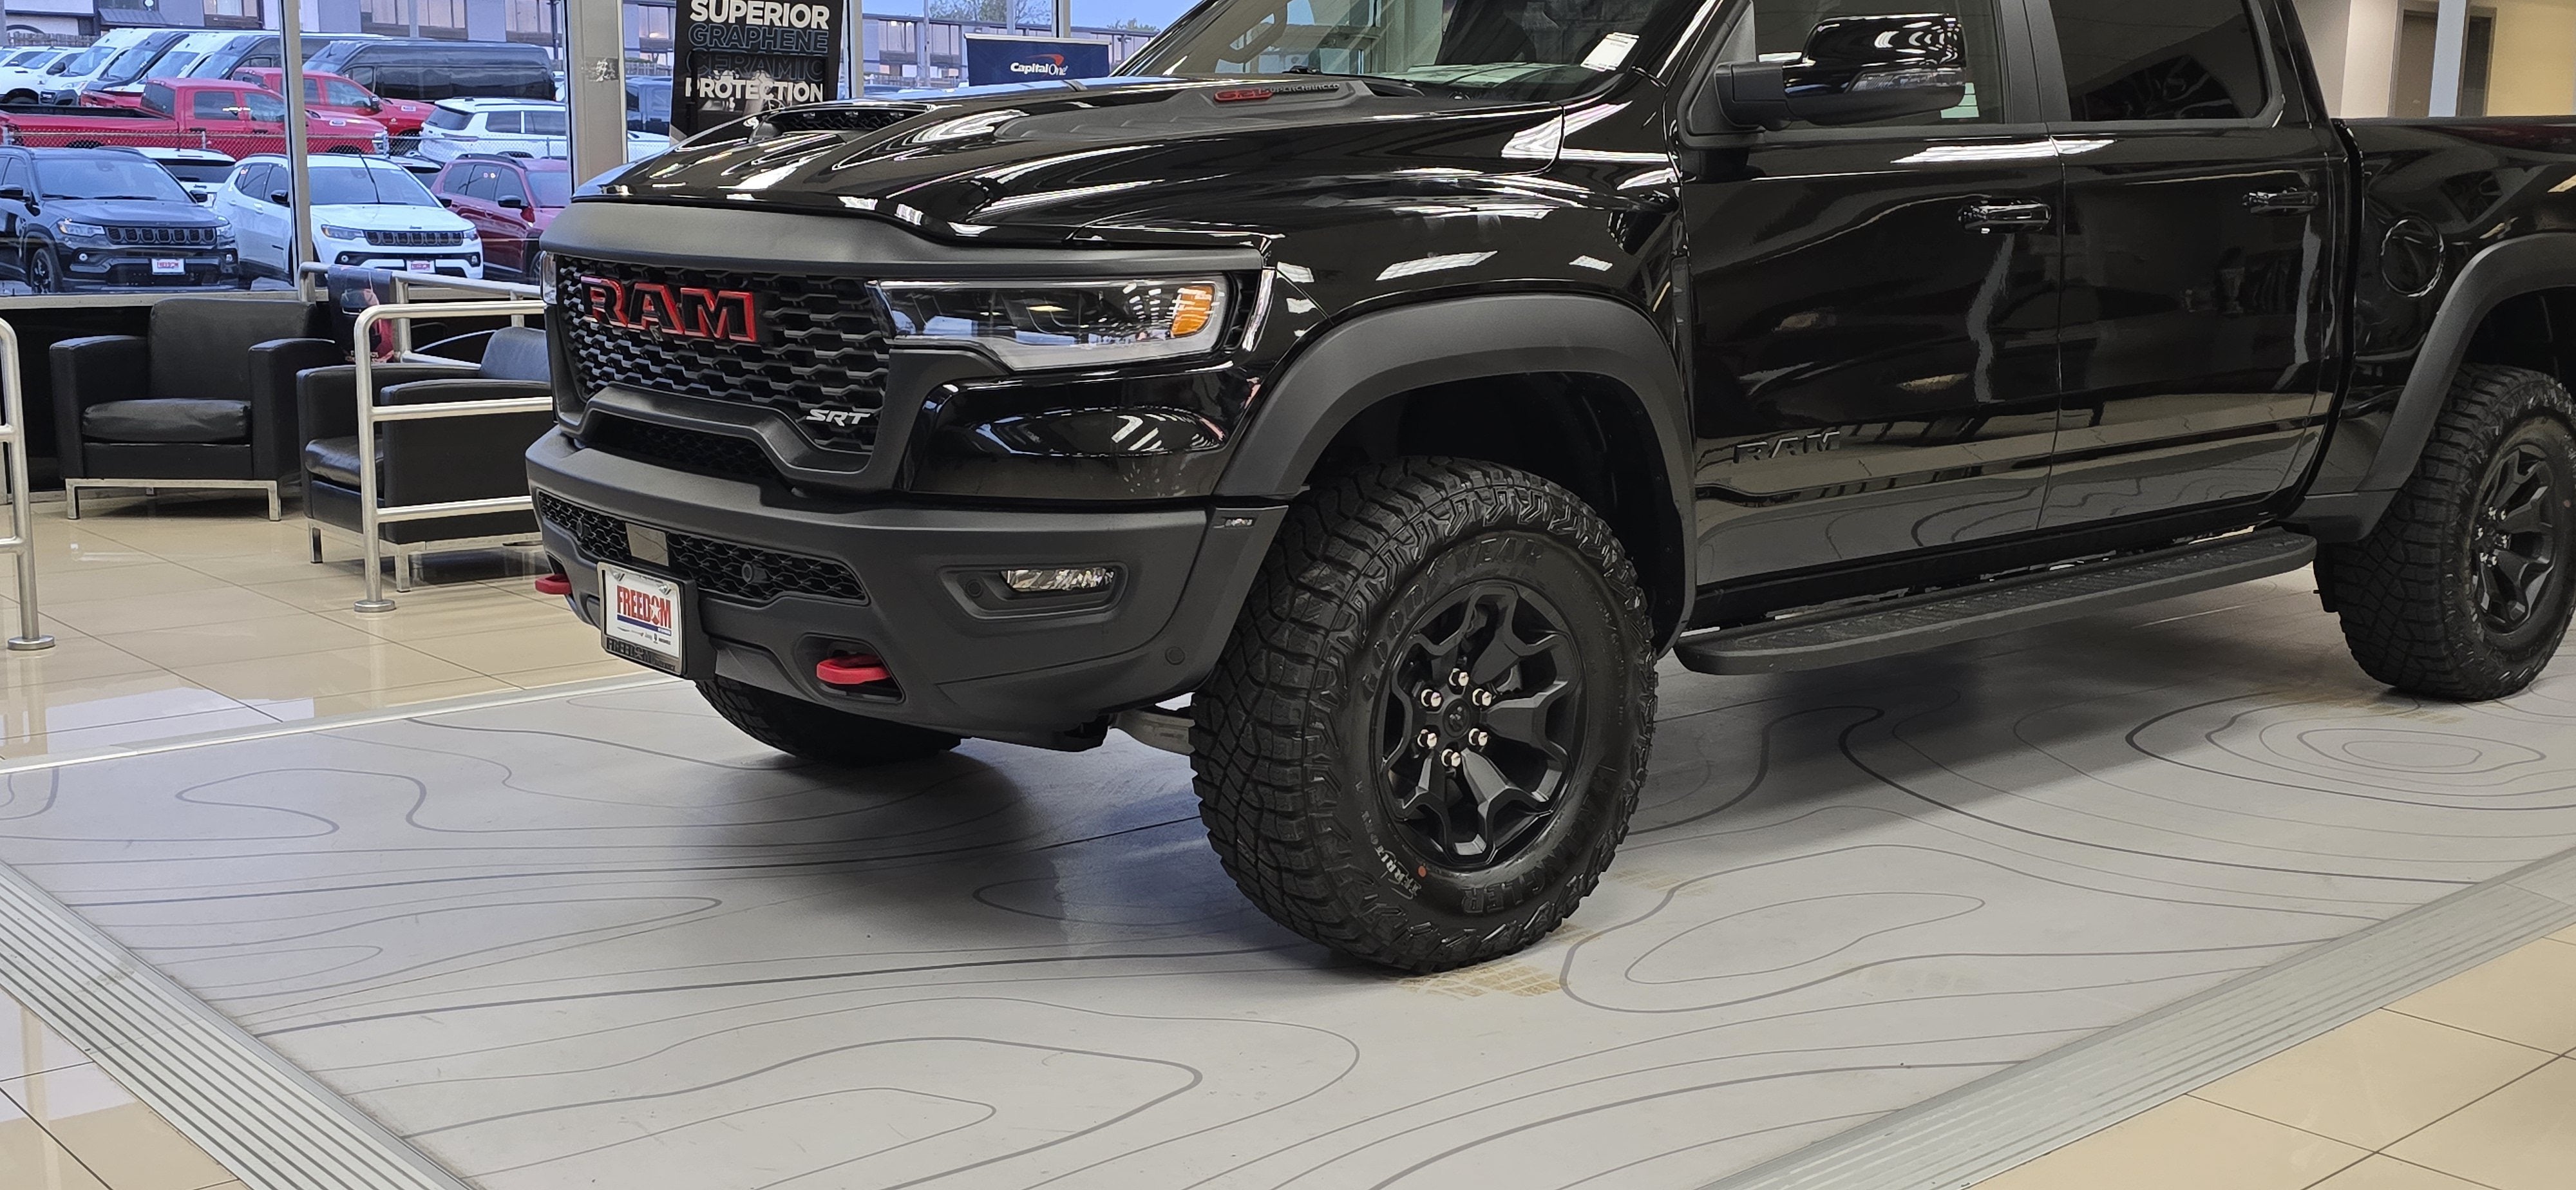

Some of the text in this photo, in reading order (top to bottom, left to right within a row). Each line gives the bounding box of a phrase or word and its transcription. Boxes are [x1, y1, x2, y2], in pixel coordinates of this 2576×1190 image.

[690, 0, 829, 30] SUPERIOR
[688, 23, 829, 53] GRAPHENE
[580, 276, 757, 343] RAM
[806, 409, 871, 426] SRT
[1733, 431, 1840, 464] RAM
[616, 585, 672, 629] FREEDOM
